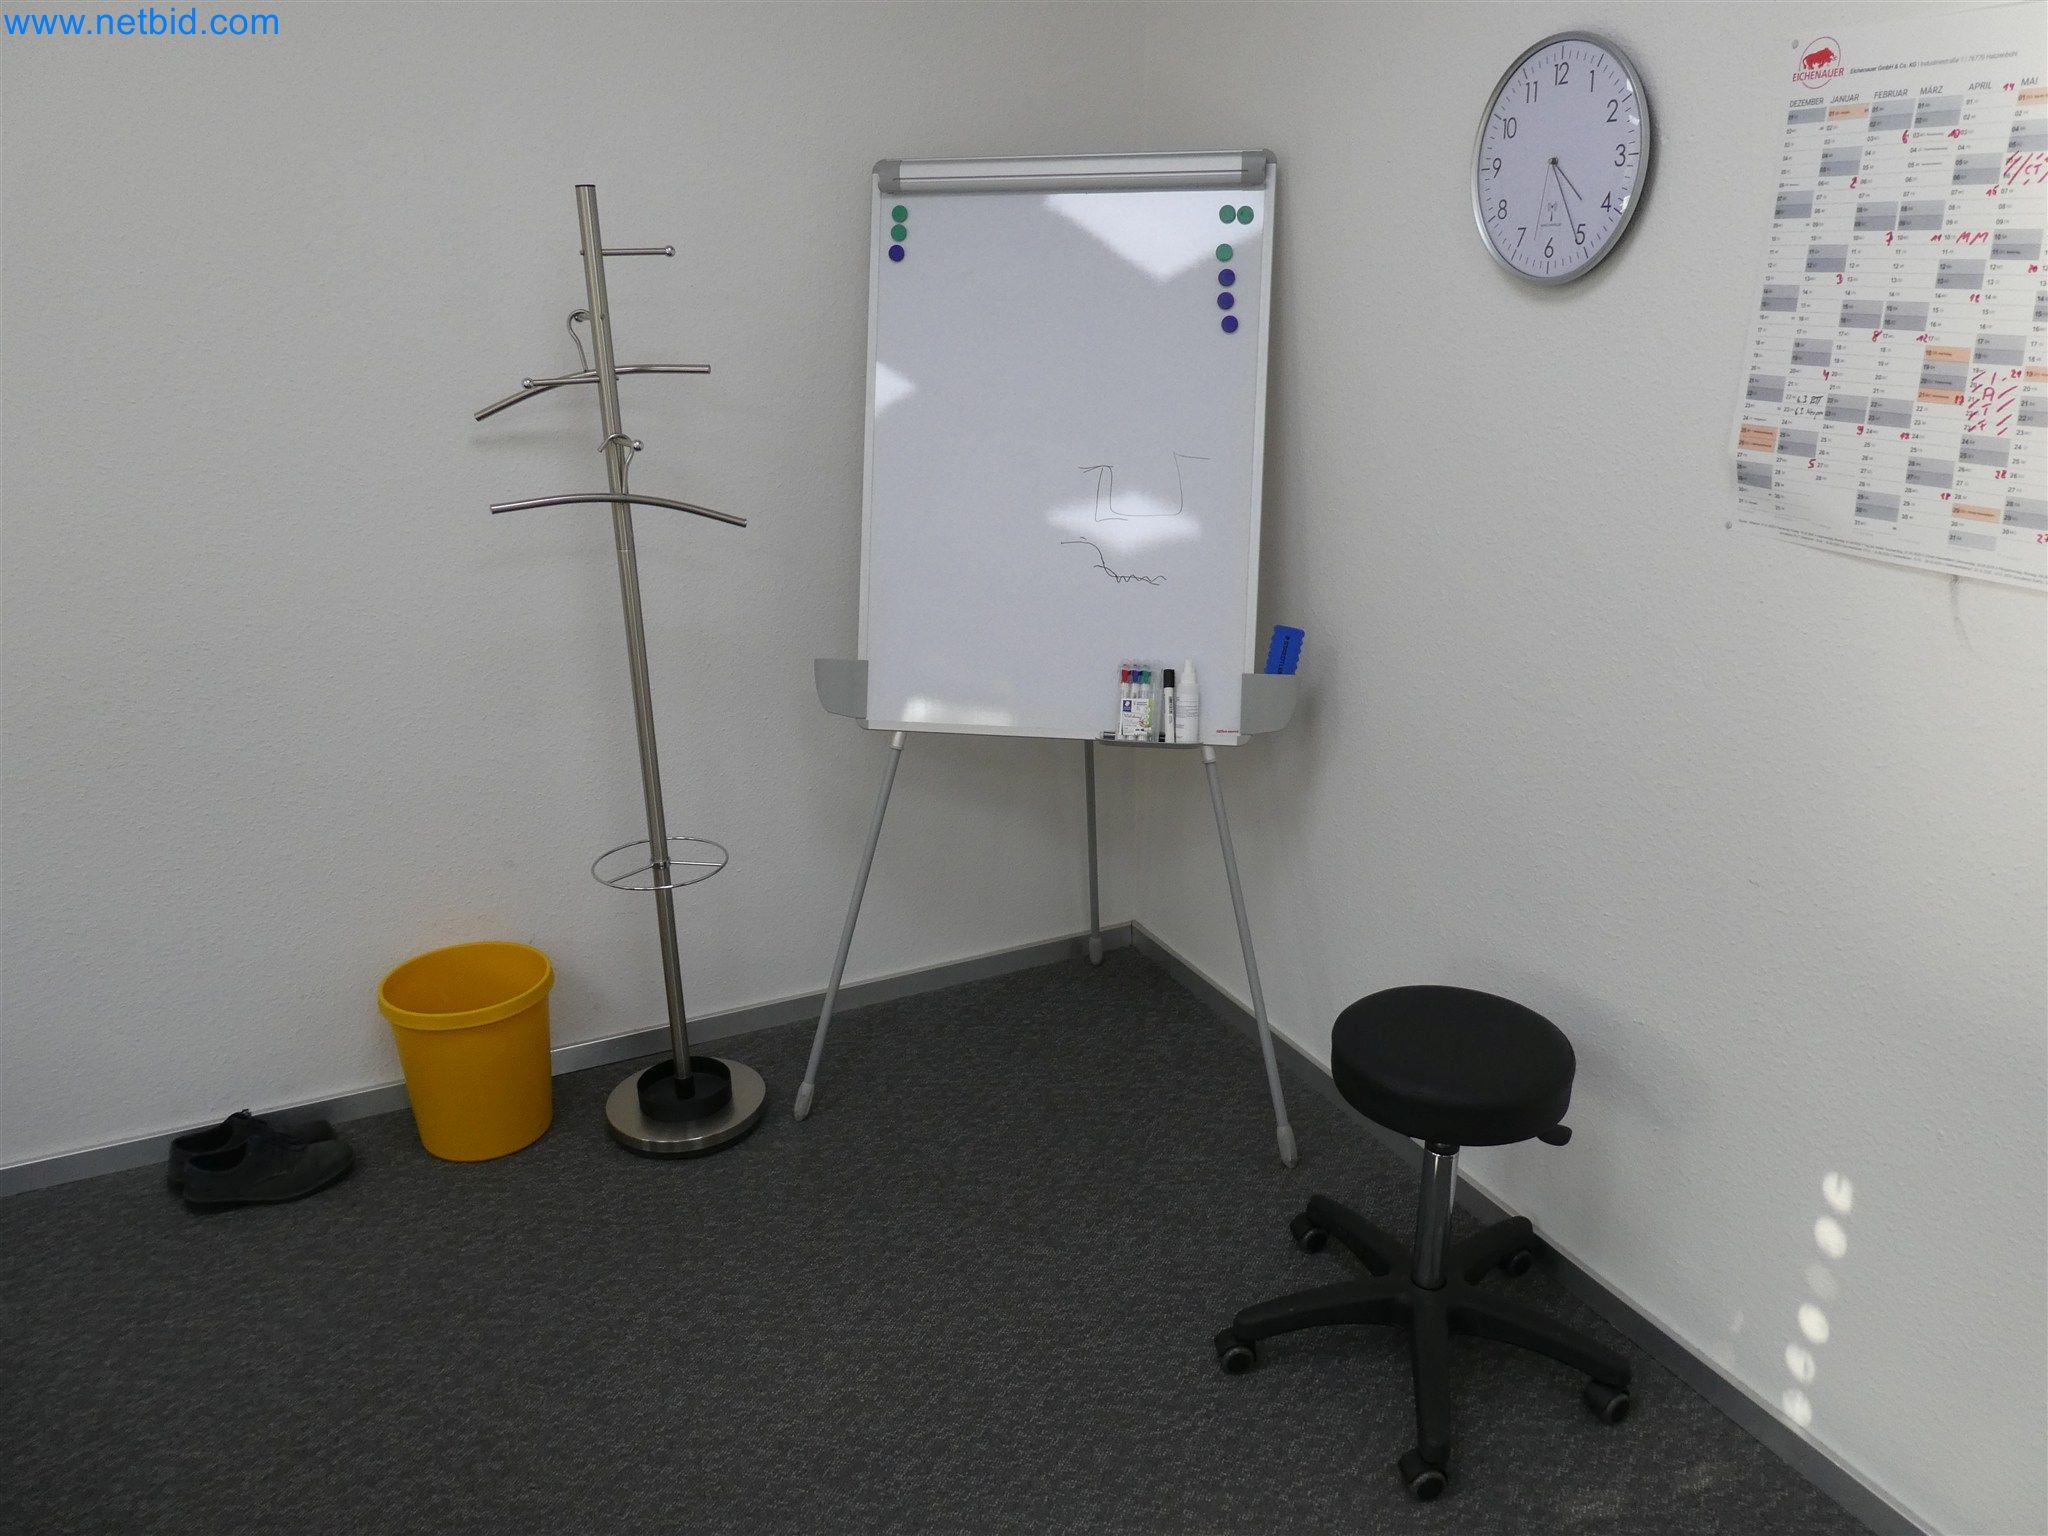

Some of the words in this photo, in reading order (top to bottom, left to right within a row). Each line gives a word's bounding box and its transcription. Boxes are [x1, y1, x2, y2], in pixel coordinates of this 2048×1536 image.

[1554, 62, 1570, 86] 12
[1590, 69, 1595, 92] 1
[1792, 67, 1845, 82] EICHENAUER
[2021, 77, 2038, 86] MAI
[1526, 81, 1538, 104] 11
[1874, 89, 1908, 98] FEBRUAR
[1968, 81, 1992, 90] APRIL
[1790, 98, 1824, 108] DEZEMBER
[1830, 94, 1860, 103] JANUAR
[1606, 99, 1618, 123] 2
[1502, 117, 1517, 140] 10
[1902, 130, 1909, 144] 6
[1614, 144, 1626, 167] 3
[1492, 158, 1502, 178] 9
[1850, 176, 1857, 188] 2
[1498, 199, 1508, 220] 8
[1600, 191, 1612, 212] 4
[1517, 227, 1527, 248] 7
[1574, 224, 1586, 245] 5
[1544, 237, 1554, 258] 6
[1836, 274, 1843, 284] 3
[1982, 387, 1995, 401] A
[1808, 459, 1816, 468] 5
